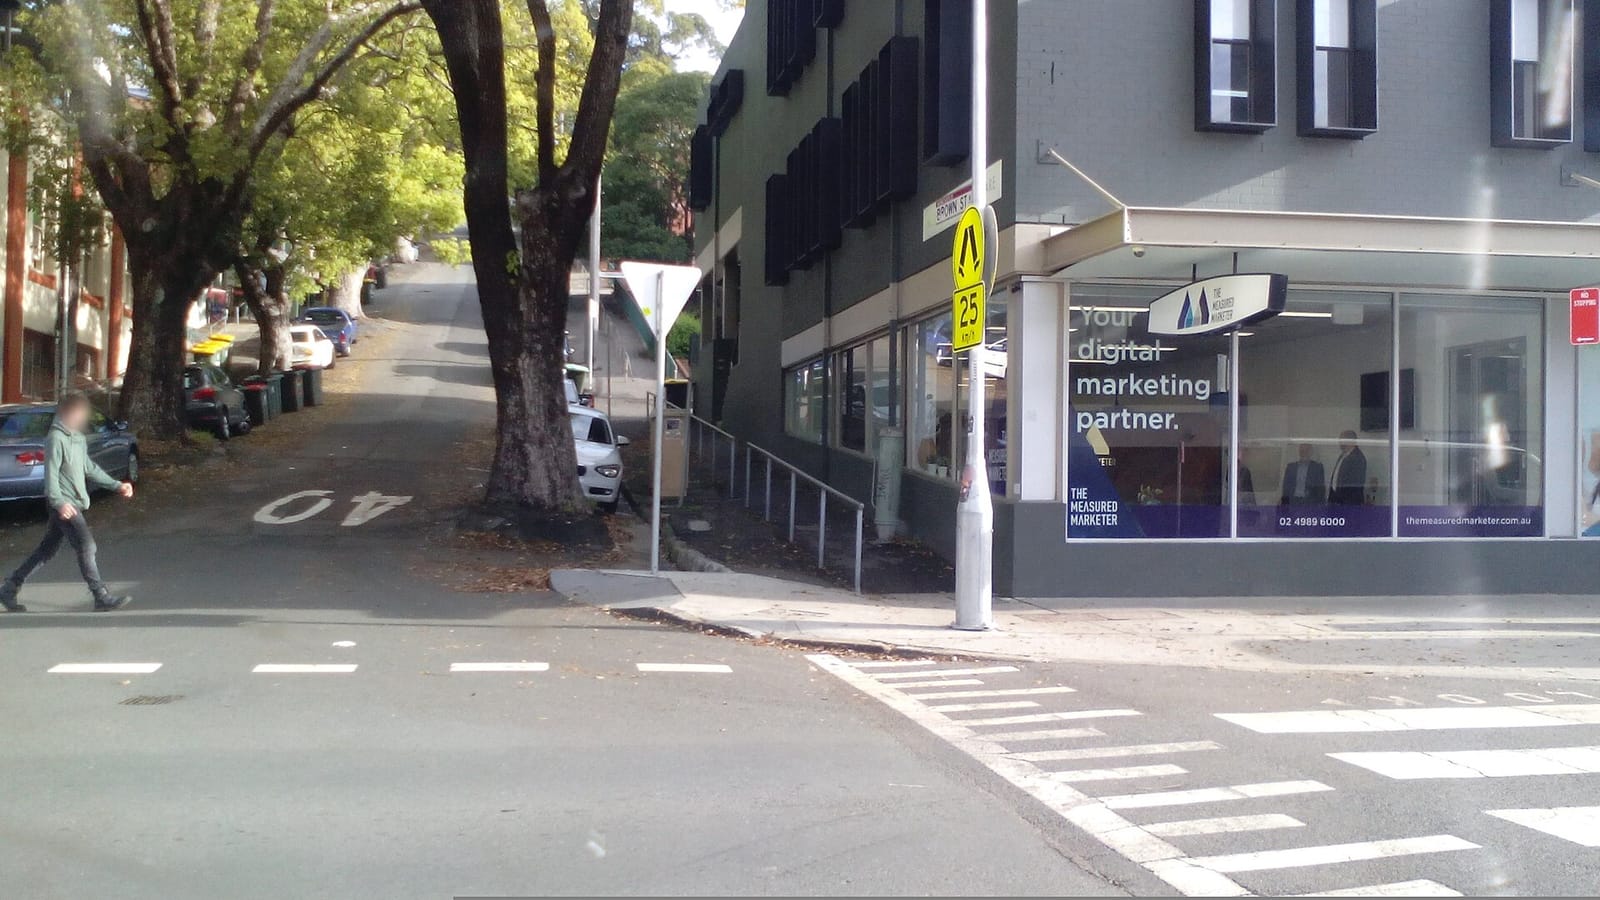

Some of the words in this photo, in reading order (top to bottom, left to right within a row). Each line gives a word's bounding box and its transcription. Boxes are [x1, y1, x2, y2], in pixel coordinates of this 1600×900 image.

[937, 200, 958, 221] BROWN
[960, 195, 967, 210] ST
[1213, 287, 1222, 298] THE
[1580, 291, 1589, 299] NO
[1212, 297, 1234, 311] MEASURED
[1573, 299, 1597, 307] STOPPING
[959, 292, 978, 328] 25
[1078, 305, 1137, 327] Your
[1211, 310, 1233, 321] MARKETER
[1077, 339, 1161, 366] digital
[1077, 373, 1210, 400] marketing
[1077, 408, 1179, 433] partner.
[1071, 487, 1088, 499] THE
[253, 489, 413, 526] 40
[1070, 501, 1118, 512] MEASURED
[1070, 514, 1118, 526] MARKETER
[1279, 517, 1291, 526] 02
[1294, 517, 1318, 526] 4989
[1320, 517, 1345, 526] 6000
[1406, 516, 1531, 525] themeasuredmarketer.com.au
